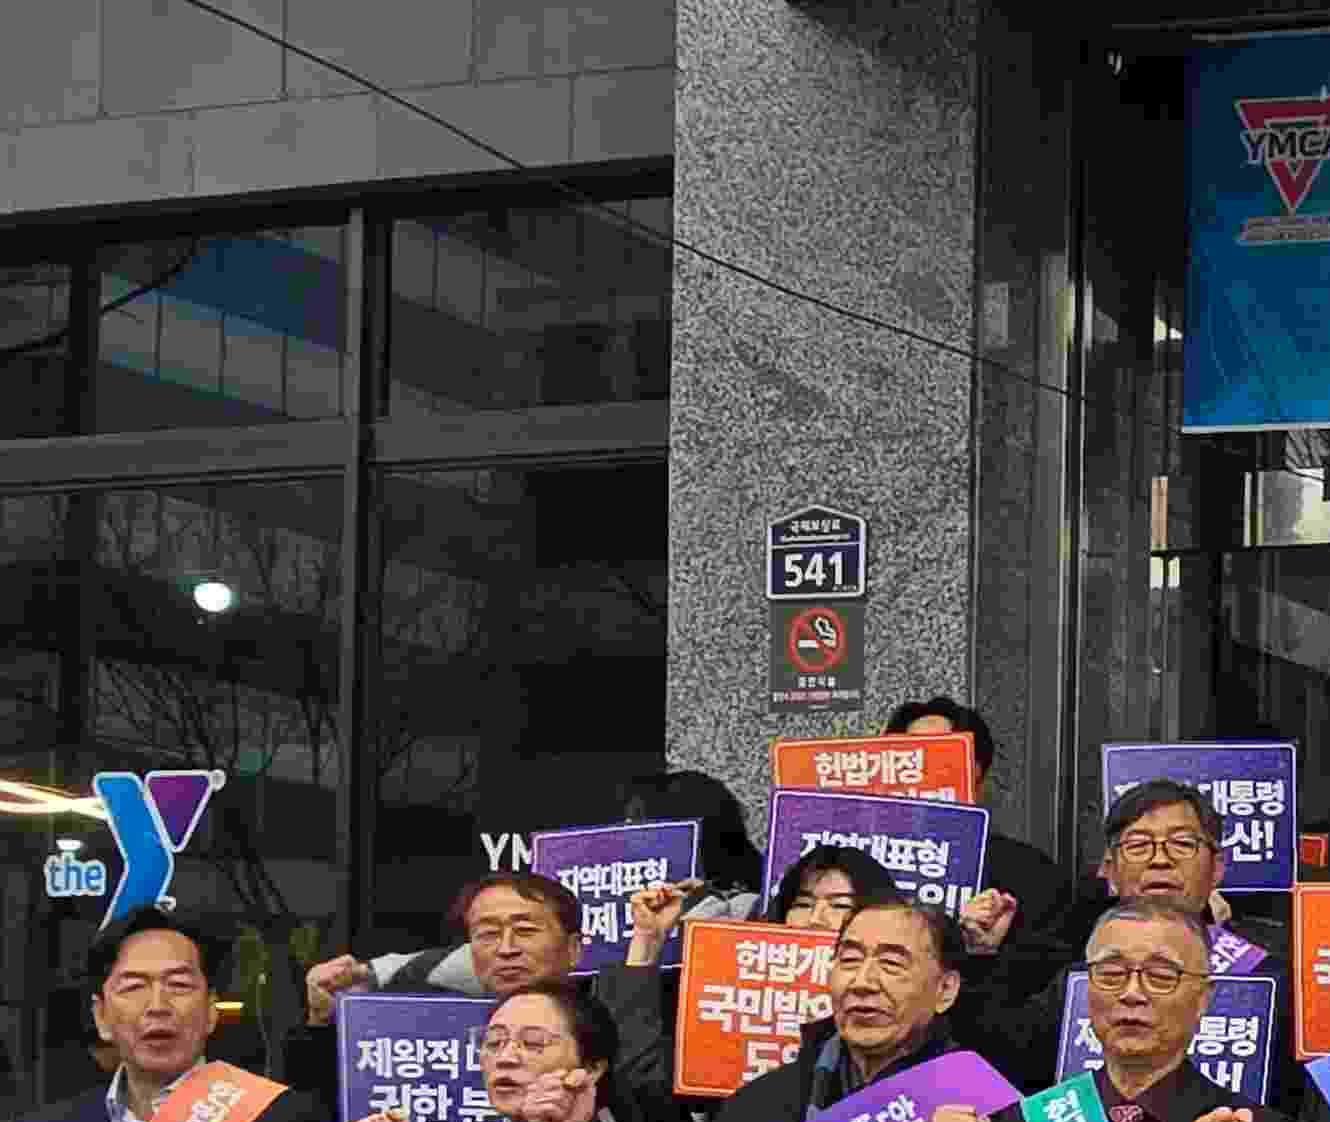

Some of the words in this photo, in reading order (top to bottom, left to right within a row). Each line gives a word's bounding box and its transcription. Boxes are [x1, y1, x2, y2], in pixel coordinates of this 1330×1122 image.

[784, 552, 843, 587] 541
[813, 749, 924, 787] 헌법개정
[1220, 820, 1275, 862] 산!
[45, 844, 105, 896] the
[356, 1037, 460, 1080] 제왕적
